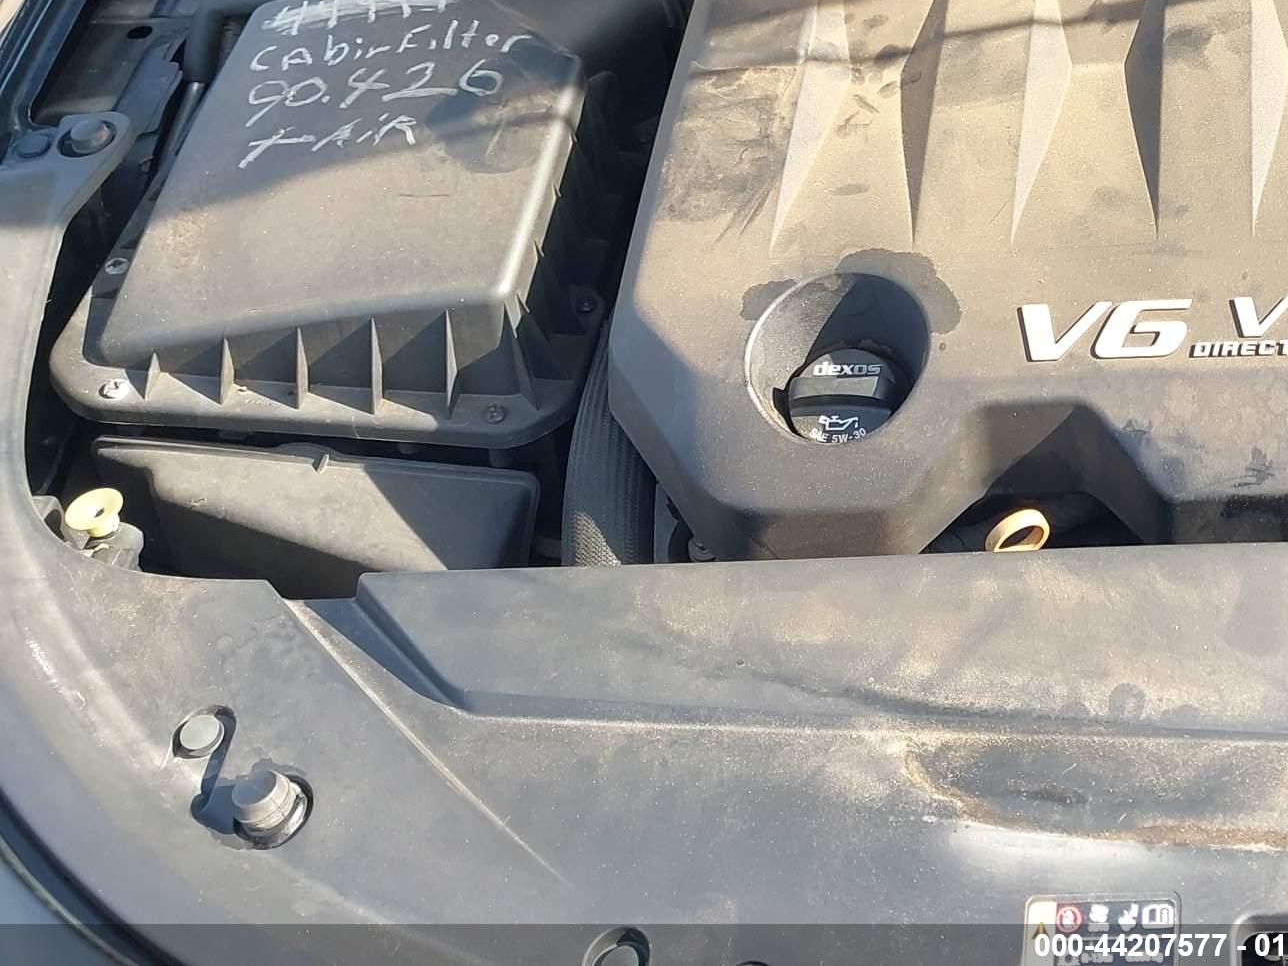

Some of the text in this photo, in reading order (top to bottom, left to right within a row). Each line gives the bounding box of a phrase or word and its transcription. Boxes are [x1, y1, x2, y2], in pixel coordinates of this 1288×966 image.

[1017, 298, 1193, 362] V6
[813, 361, 883, 376] dexos
[832, 428, 867, 444] 5W-30
